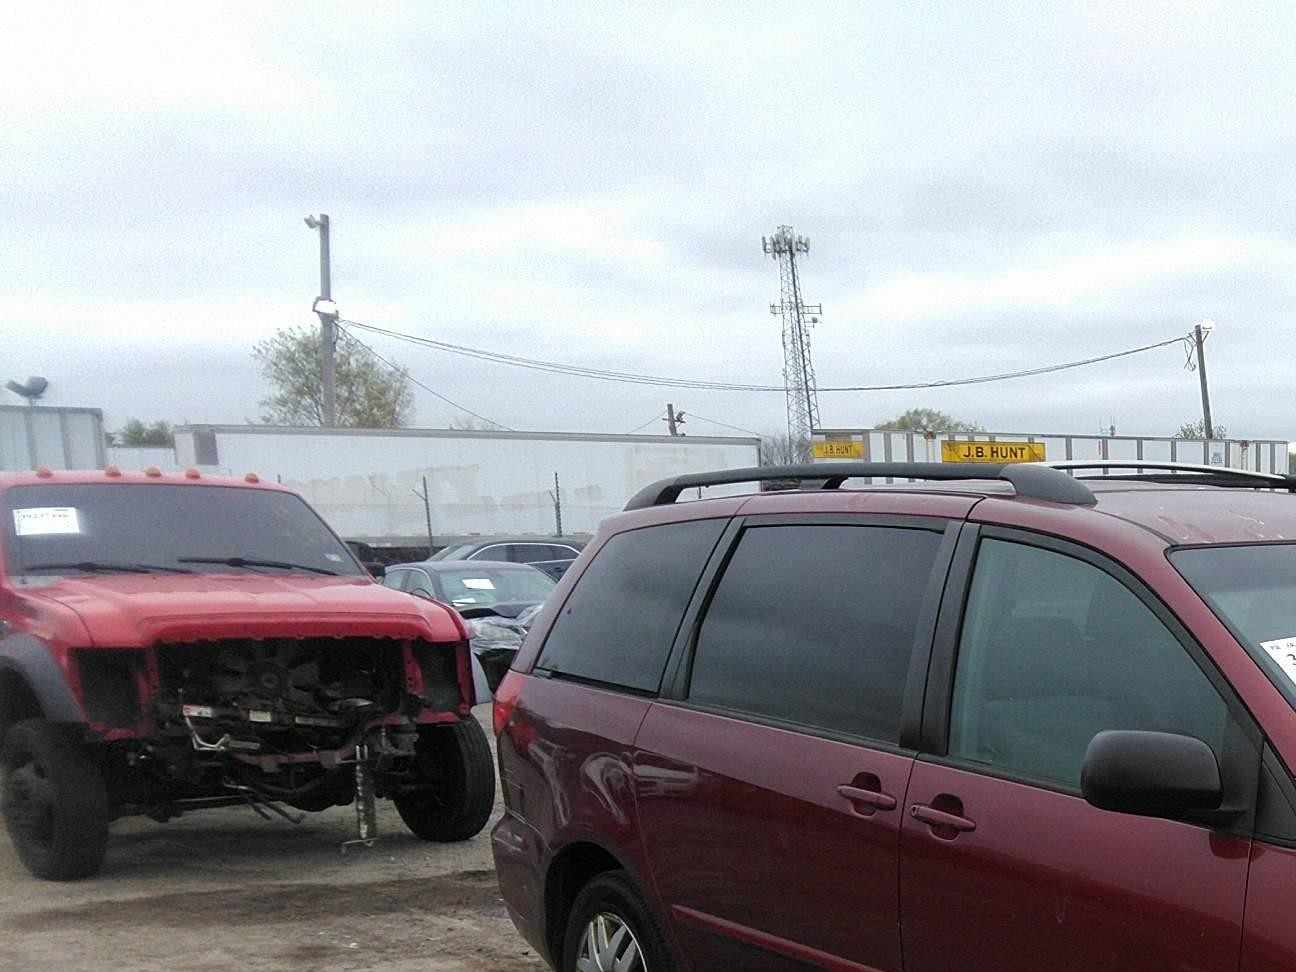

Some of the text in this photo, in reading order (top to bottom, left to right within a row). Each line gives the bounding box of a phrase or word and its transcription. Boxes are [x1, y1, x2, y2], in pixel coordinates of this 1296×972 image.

[835, 444, 853, 456] HUNT
[963, 445, 1027, 460] J.B. HUNT
